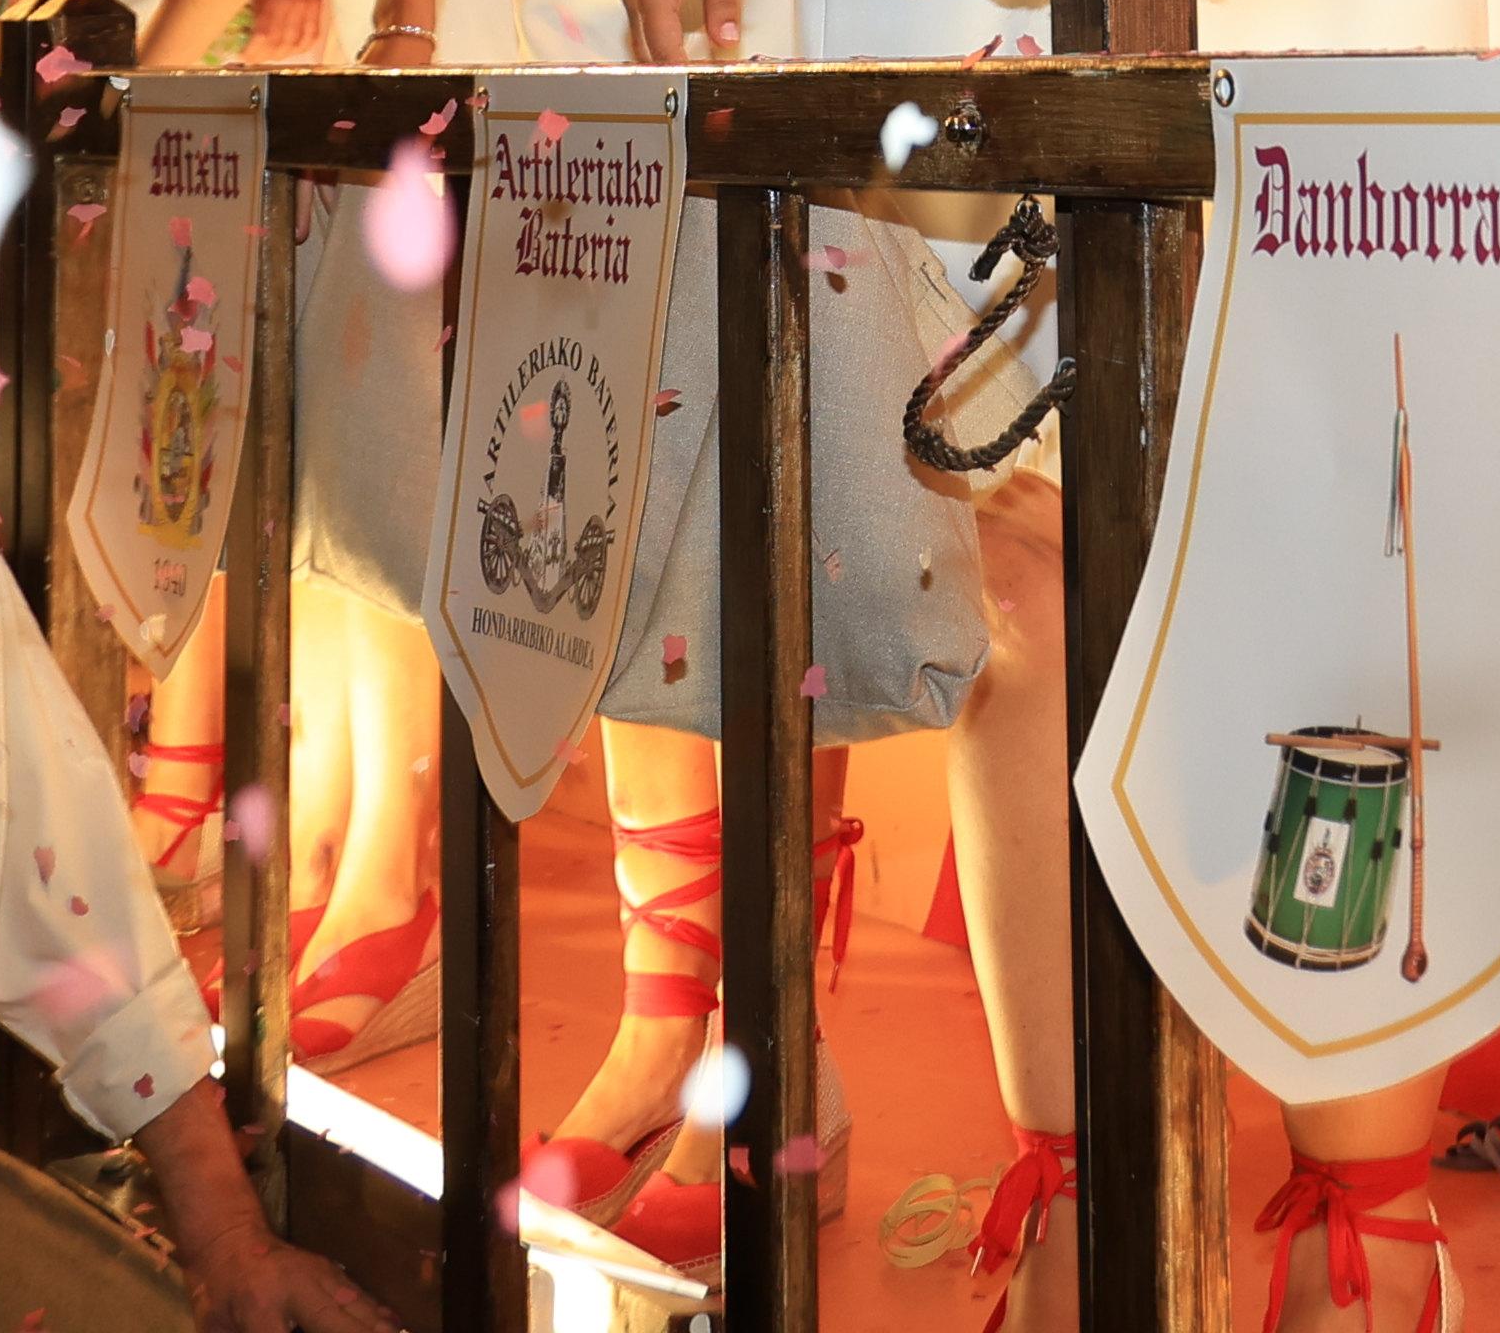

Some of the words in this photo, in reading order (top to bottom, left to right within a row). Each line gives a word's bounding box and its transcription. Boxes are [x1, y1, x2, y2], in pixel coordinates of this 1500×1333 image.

[149, 129, 240, 199] Mixta
[491, 133, 663, 208] Artileriako
[514, 206, 632, 284] Bateria
[483, 336, 583, 495] ARTILERIAKO
[587, 354, 620, 522] BATERIA
[472, 606, 555, 655] HONDARRIBIKO
